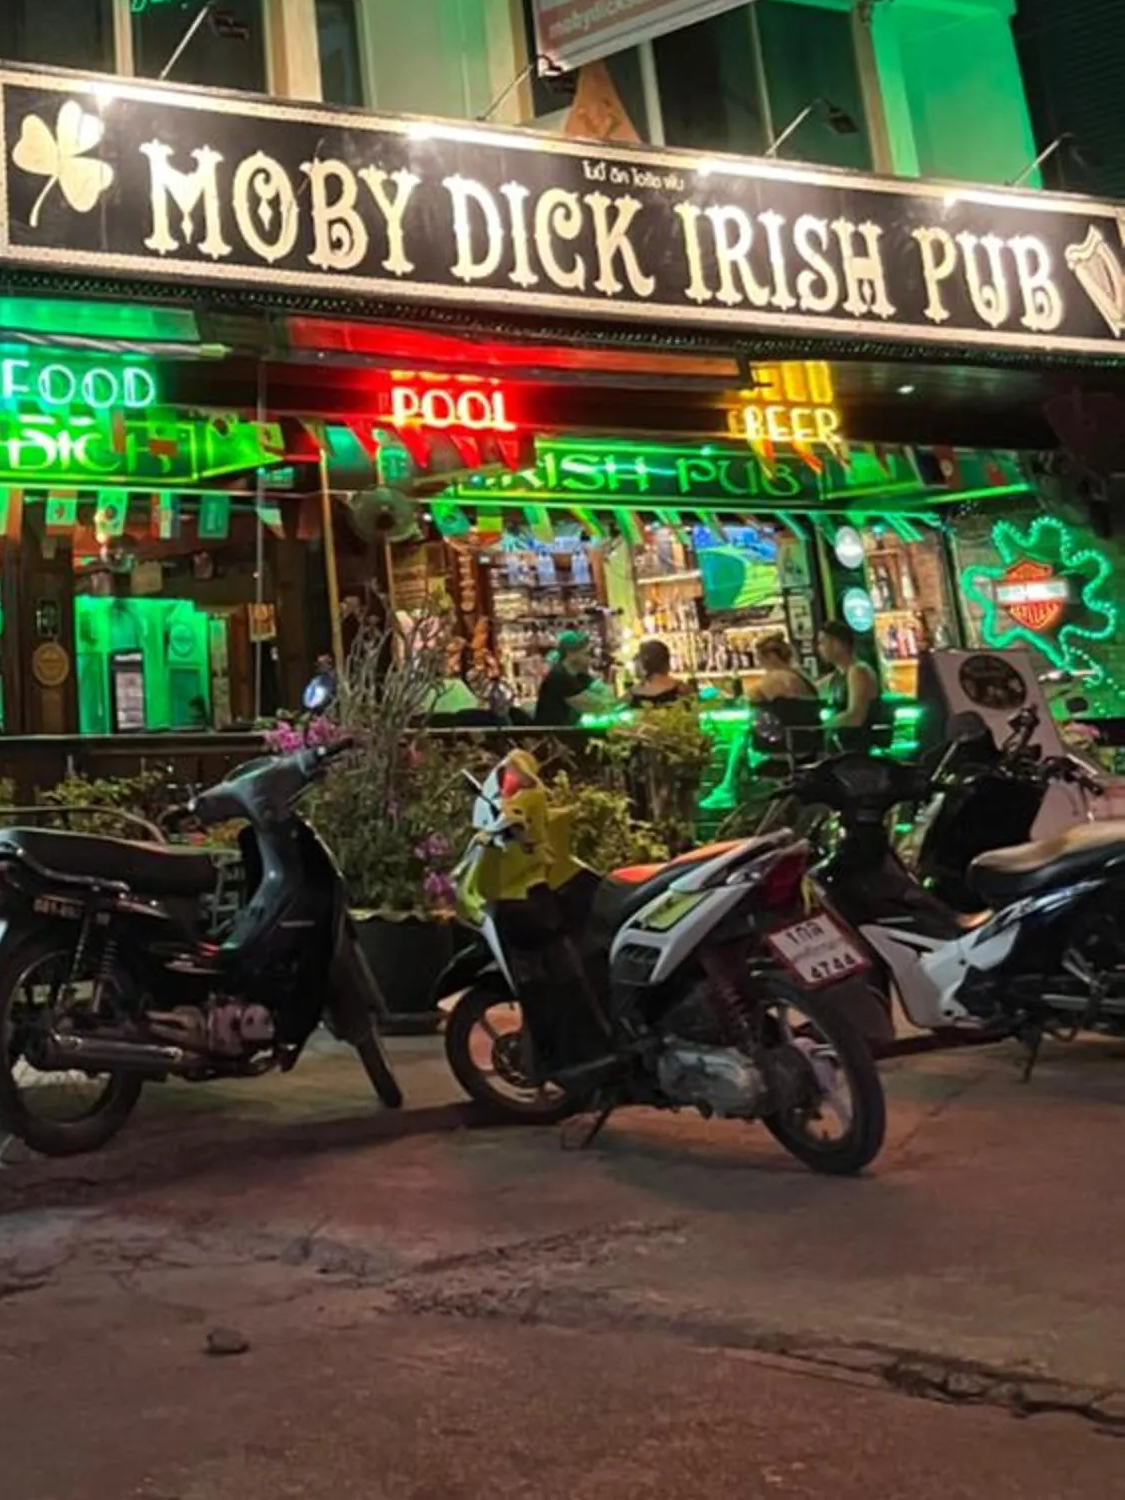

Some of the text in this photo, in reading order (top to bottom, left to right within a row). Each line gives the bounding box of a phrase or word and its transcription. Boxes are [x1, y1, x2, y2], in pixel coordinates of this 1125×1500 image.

[139, 138, 1063, 332] MOBY DICK IRISH PUB
[1, 358, 156, 409] FOOD
[391, 386, 516, 431] POOL
[742, 405, 843, 443] BEER
[675, 455, 803, 498] PUB
